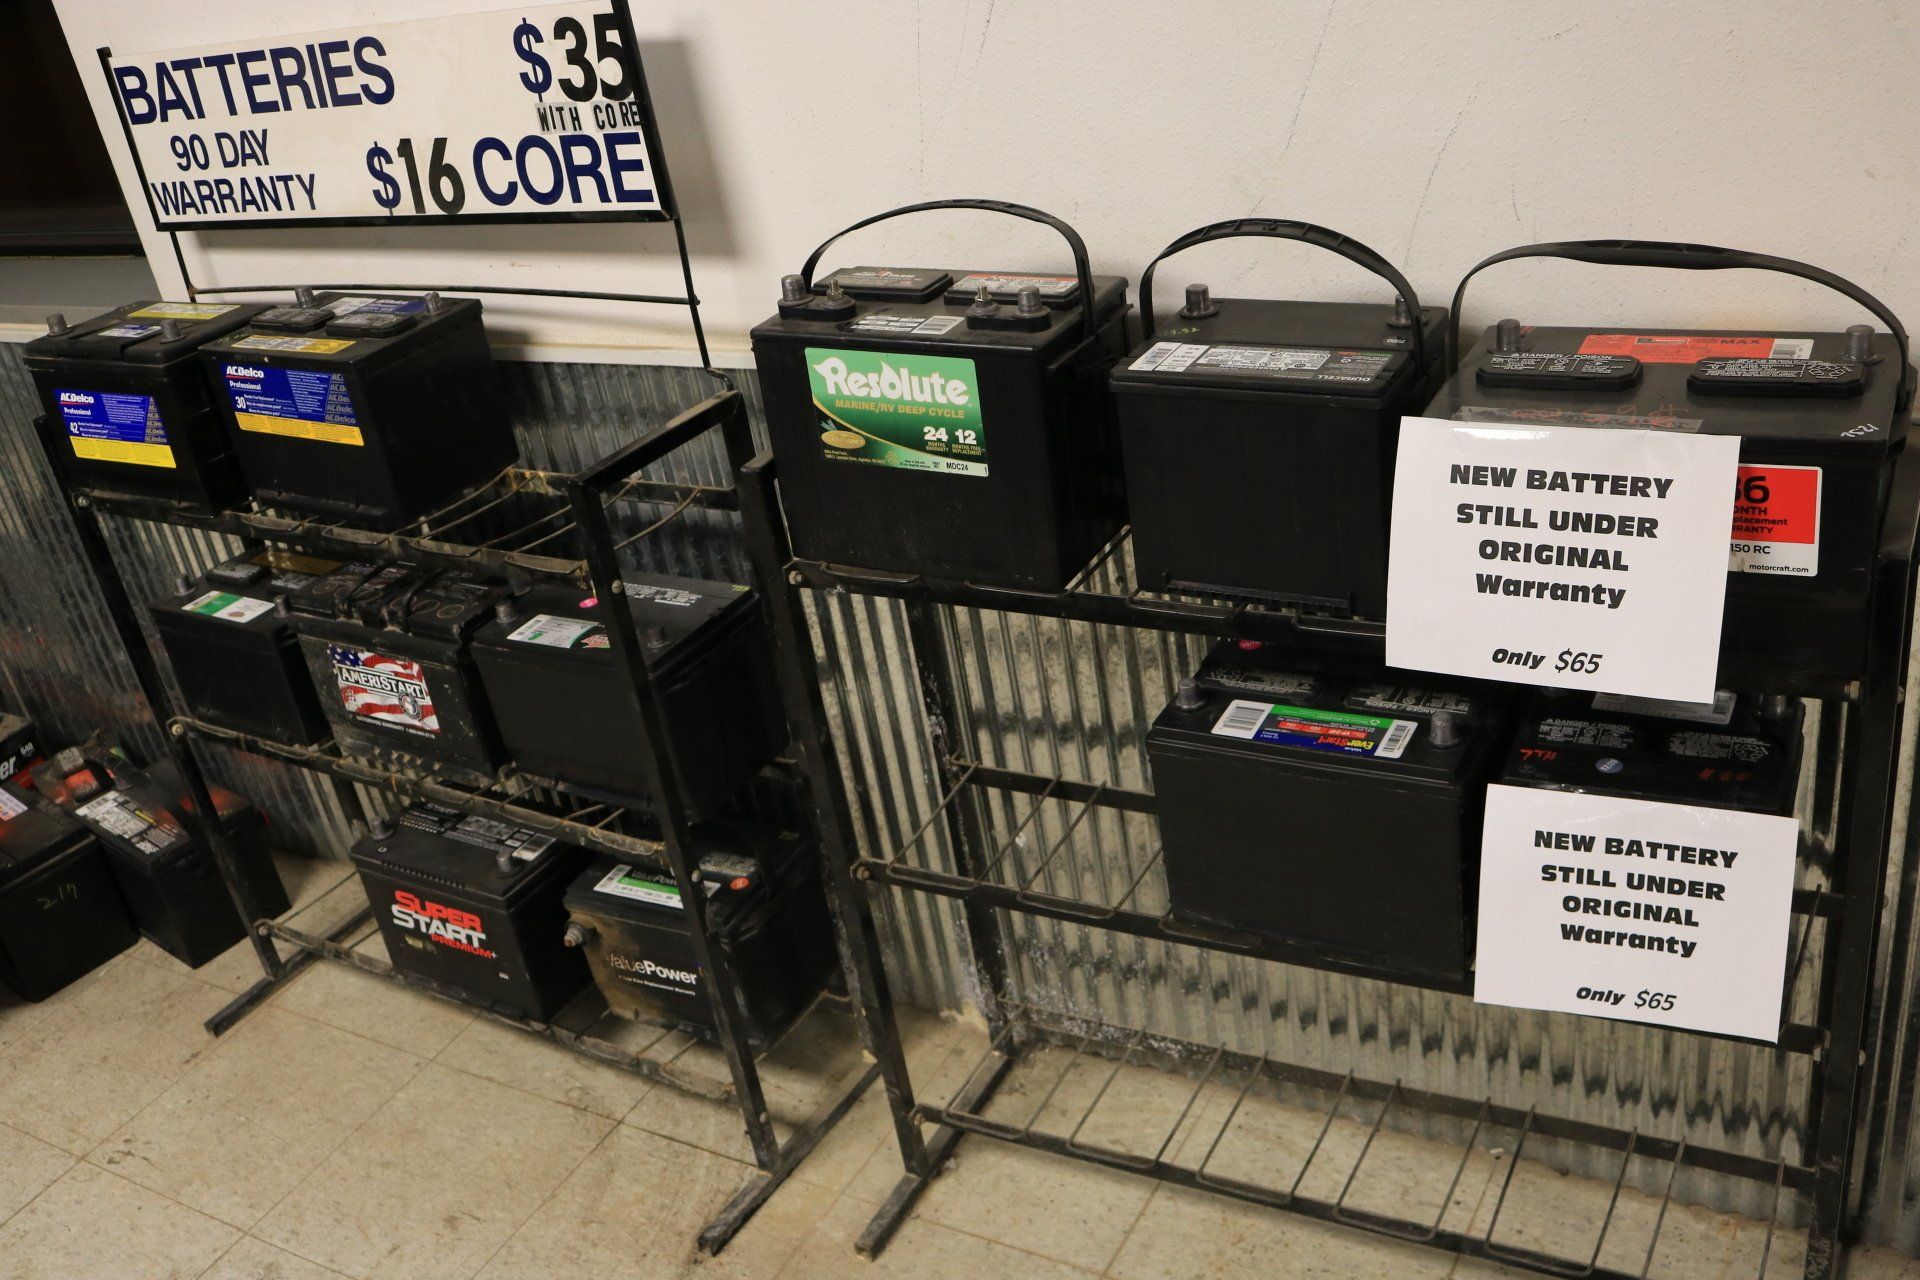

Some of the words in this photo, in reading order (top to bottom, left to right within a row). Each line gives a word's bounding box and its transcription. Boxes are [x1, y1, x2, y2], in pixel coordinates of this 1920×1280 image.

[512, 12, 634, 102] $35
[113, 36, 395, 126] BATTERIES
[538, 103, 583, 132] WITH
[594, 100, 641, 131] CORE
[170, 134, 208, 171] 90
[220, 128, 269, 169] DAY
[366, 137, 466, 217] $16
[472, 132, 654, 206] CORE
[151, 174, 317, 216] WARRANTY
[226, 365, 265, 379] ACDelco
[229, 380, 262, 390] Professional
[813, 357, 970, 406] Resolute
[1317, 374, 1371, 382] DURACELL
[60, 392, 94, 404] ACDelco
[63, 407, 91, 416] Professional
[235, 396, 247, 409] 30
[835, 400, 895, 414] MARINE/RV
[898, 404, 926, 415] DEEP
[928, 408, 965, 418] CYCLE
[69, 421, 80, 434] 42
[923, 425, 949, 442] 24
[954, 428, 977, 445] 12
[946, 462, 969, 471] MDC24
[1450, 463, 1517, 488] NEW
[1526, 469, 1674, 499] BATTERY
[1735, 475, 1770, 504] 6
[1456, 503, 1538, 529] STILL
[1549, 510, 1659, 539] UNDER
[1478, 539, 1629, 572] ORIGINAL
[1753, 545, 1771, 555] RC
[1749, 564, 1809, 573] motorcraft.com
[1476, 573, 1627, 610] Warranty
[1491, 648, 1546, 670] Only
[1554, 648, 1603, 675] $65
[341, 666, 424, 700] AMERISTART
[1555, 719, 1590, 727] DANGER
[1317, 735, 1375, 750] EverStart
[1534, 830, 1596, 853] NEW
[1605, 837, 1739, 868] BATTERY
[1541, 864, 1616, 888] STILL
[1626, 872, 1726, 901] UNDER
[391, 904, 486, 948] START
[395, 890, 482, 933] SUPER
[1562, 895, 1700, 927] ORIGINAL
[1560, 923, 1697, 958] Warranty
[1576, 987, 1626, 1006] Only
[1634, 989, 1678, 1011] $65
